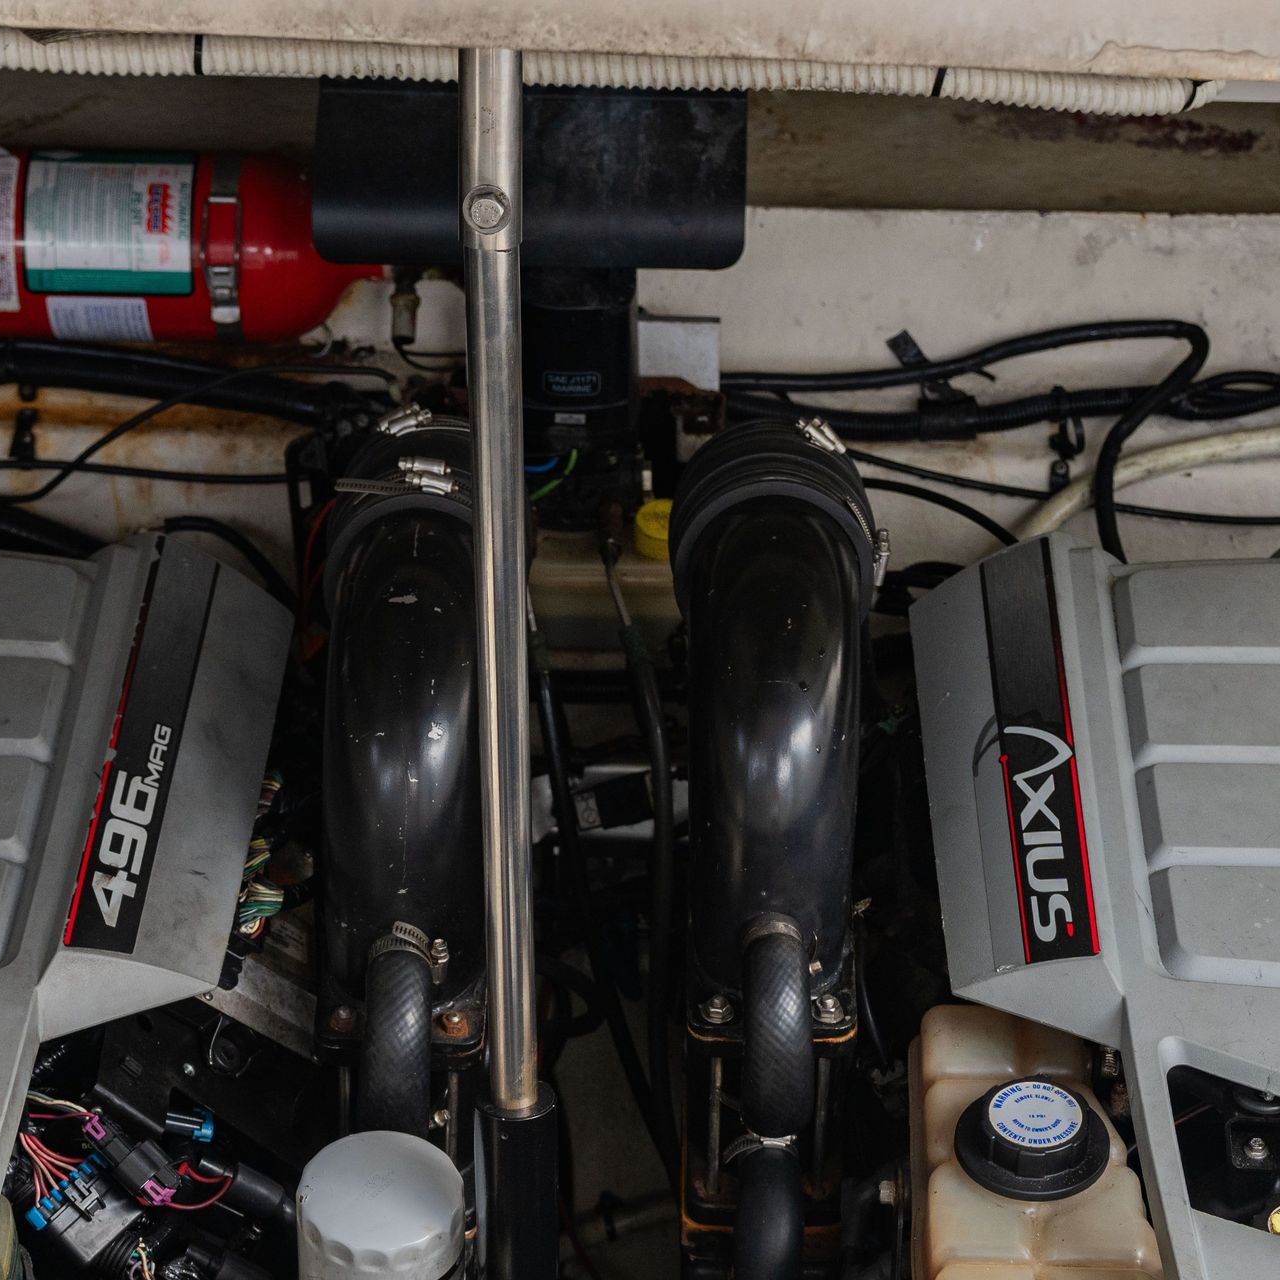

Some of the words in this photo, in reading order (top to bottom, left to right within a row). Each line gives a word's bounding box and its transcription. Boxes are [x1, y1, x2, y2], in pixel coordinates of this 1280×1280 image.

[91, 770, 159, 928] 496
[144, 723, 173, 788] MAG
[1003, 726, 1074, 943] AXIUS
[992, 1085, 1022, 1109] WARNING
[1054, 1089, 1068, 1100] OPEN
[996, 1122, 1026, 1143] CONTENTS
[1052, 1121, 1079, 1142] PRESSURE
